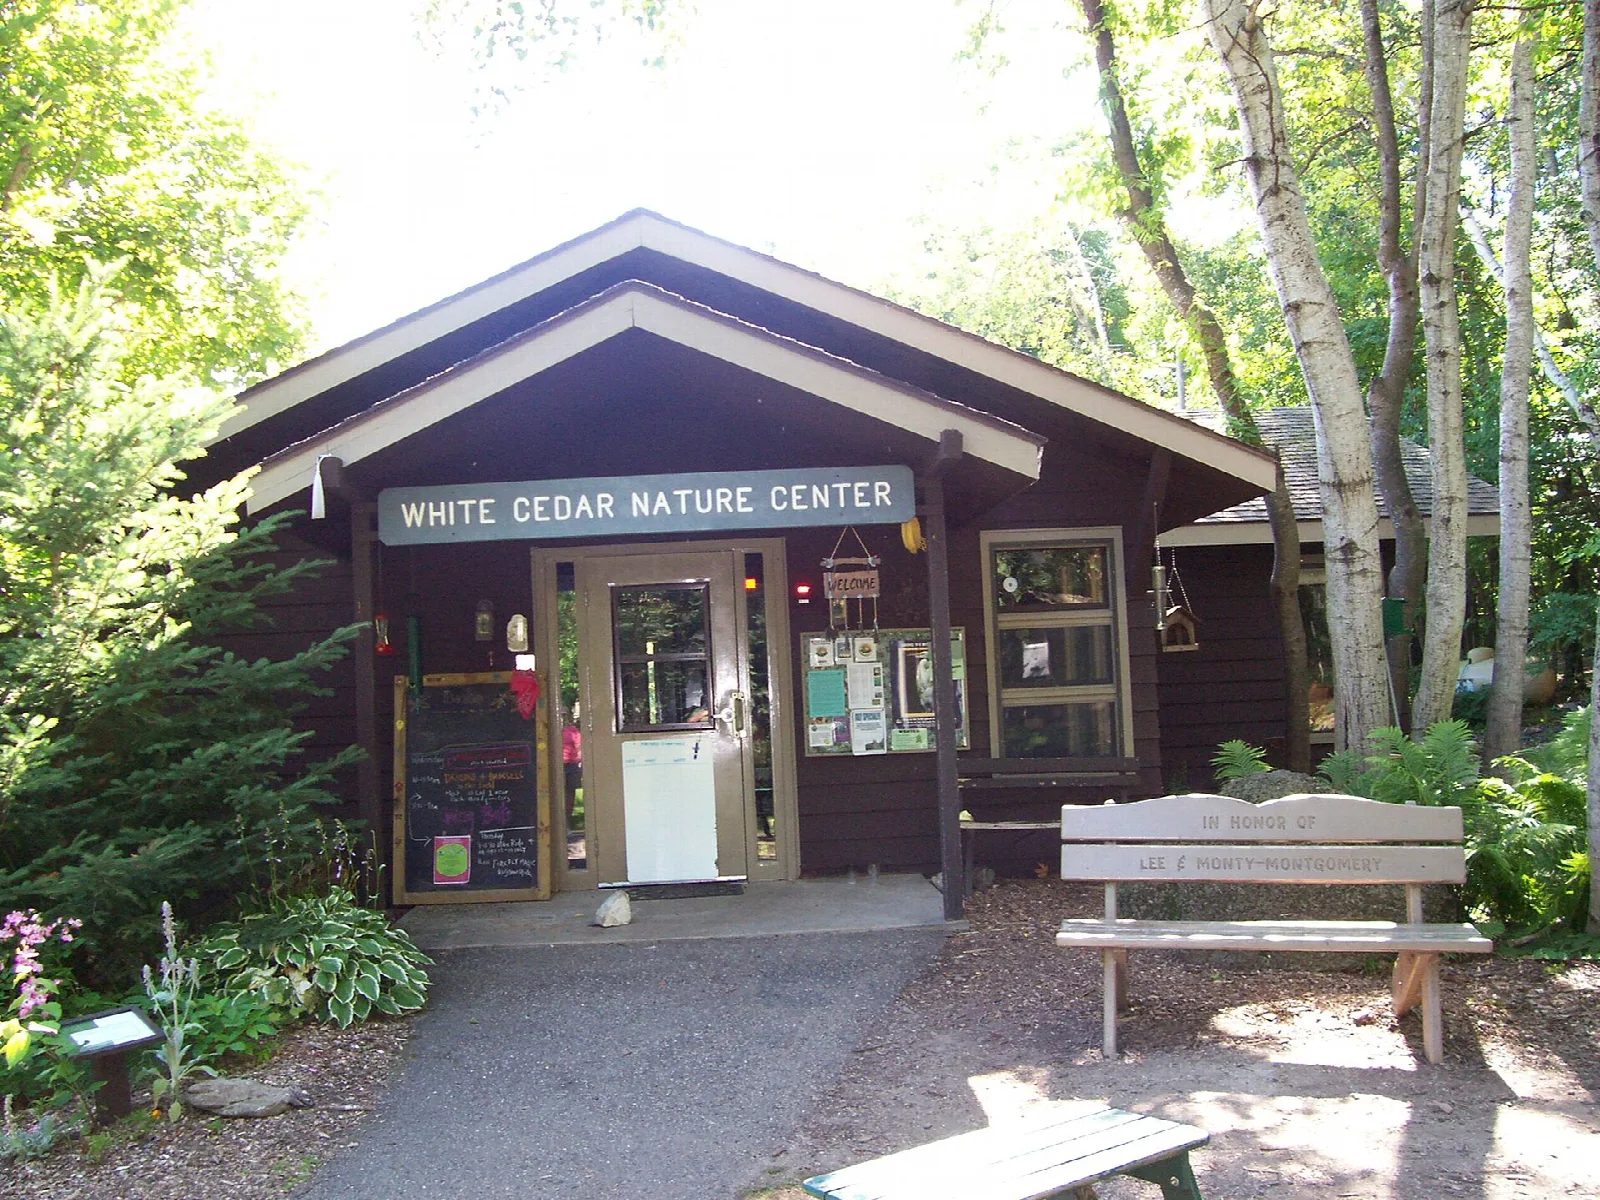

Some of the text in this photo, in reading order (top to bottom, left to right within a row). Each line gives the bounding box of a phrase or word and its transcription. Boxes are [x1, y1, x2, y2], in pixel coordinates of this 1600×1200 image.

[401, 481, 892, 528] WHITE CEDAR NATURE CENTER
[828, 577, 876, 591] WELCOME
[1202, 815, 1317, 830] IN HONOR OF
[1140, 856, 1166, 870] LEE
